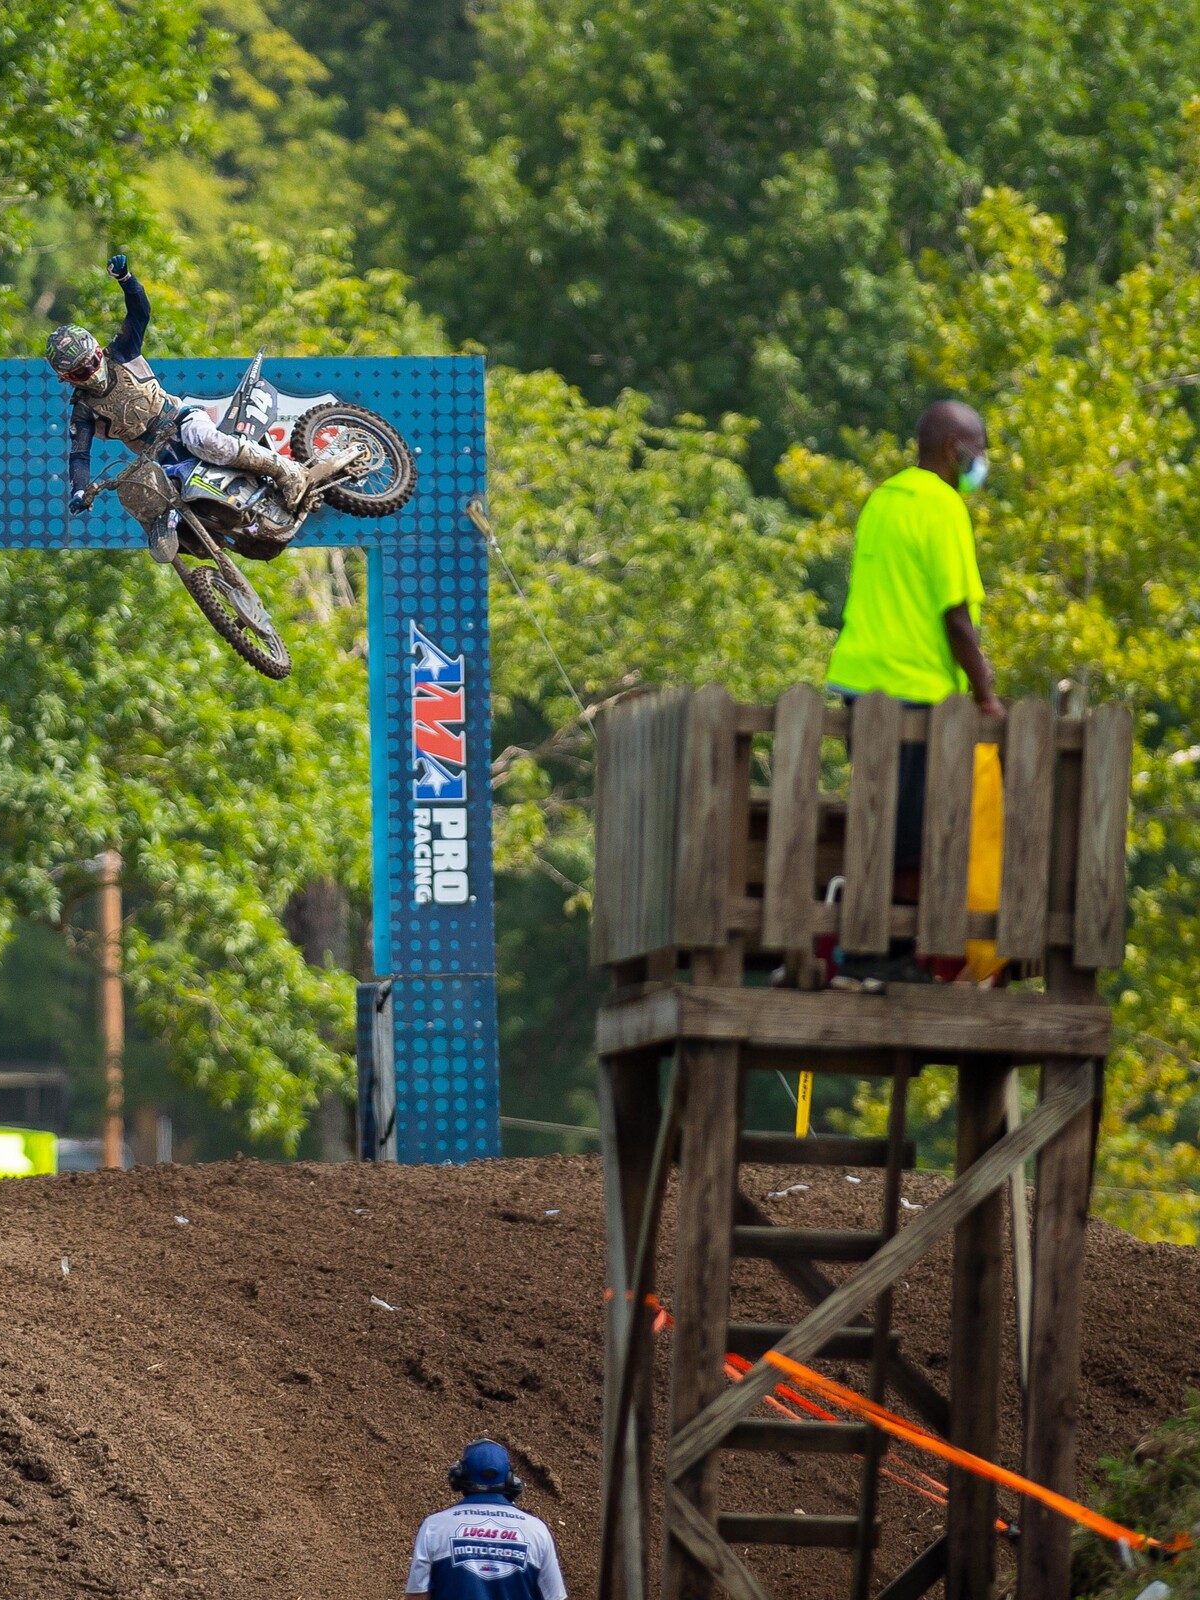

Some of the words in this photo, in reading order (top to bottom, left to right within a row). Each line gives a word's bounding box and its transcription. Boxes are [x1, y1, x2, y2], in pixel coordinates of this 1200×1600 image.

[245, 388, 273, 425] 14
[410, 619, 466, 801] AMA
[413, 807, 433, 904] RACING
[432, 807, 469, 905] PRO
[454, 1546, 526, 1560] MOTOCROSS
[463, 1527, 499, 1539] LUCAS
[500, 1530, 518, 1540] OIL
